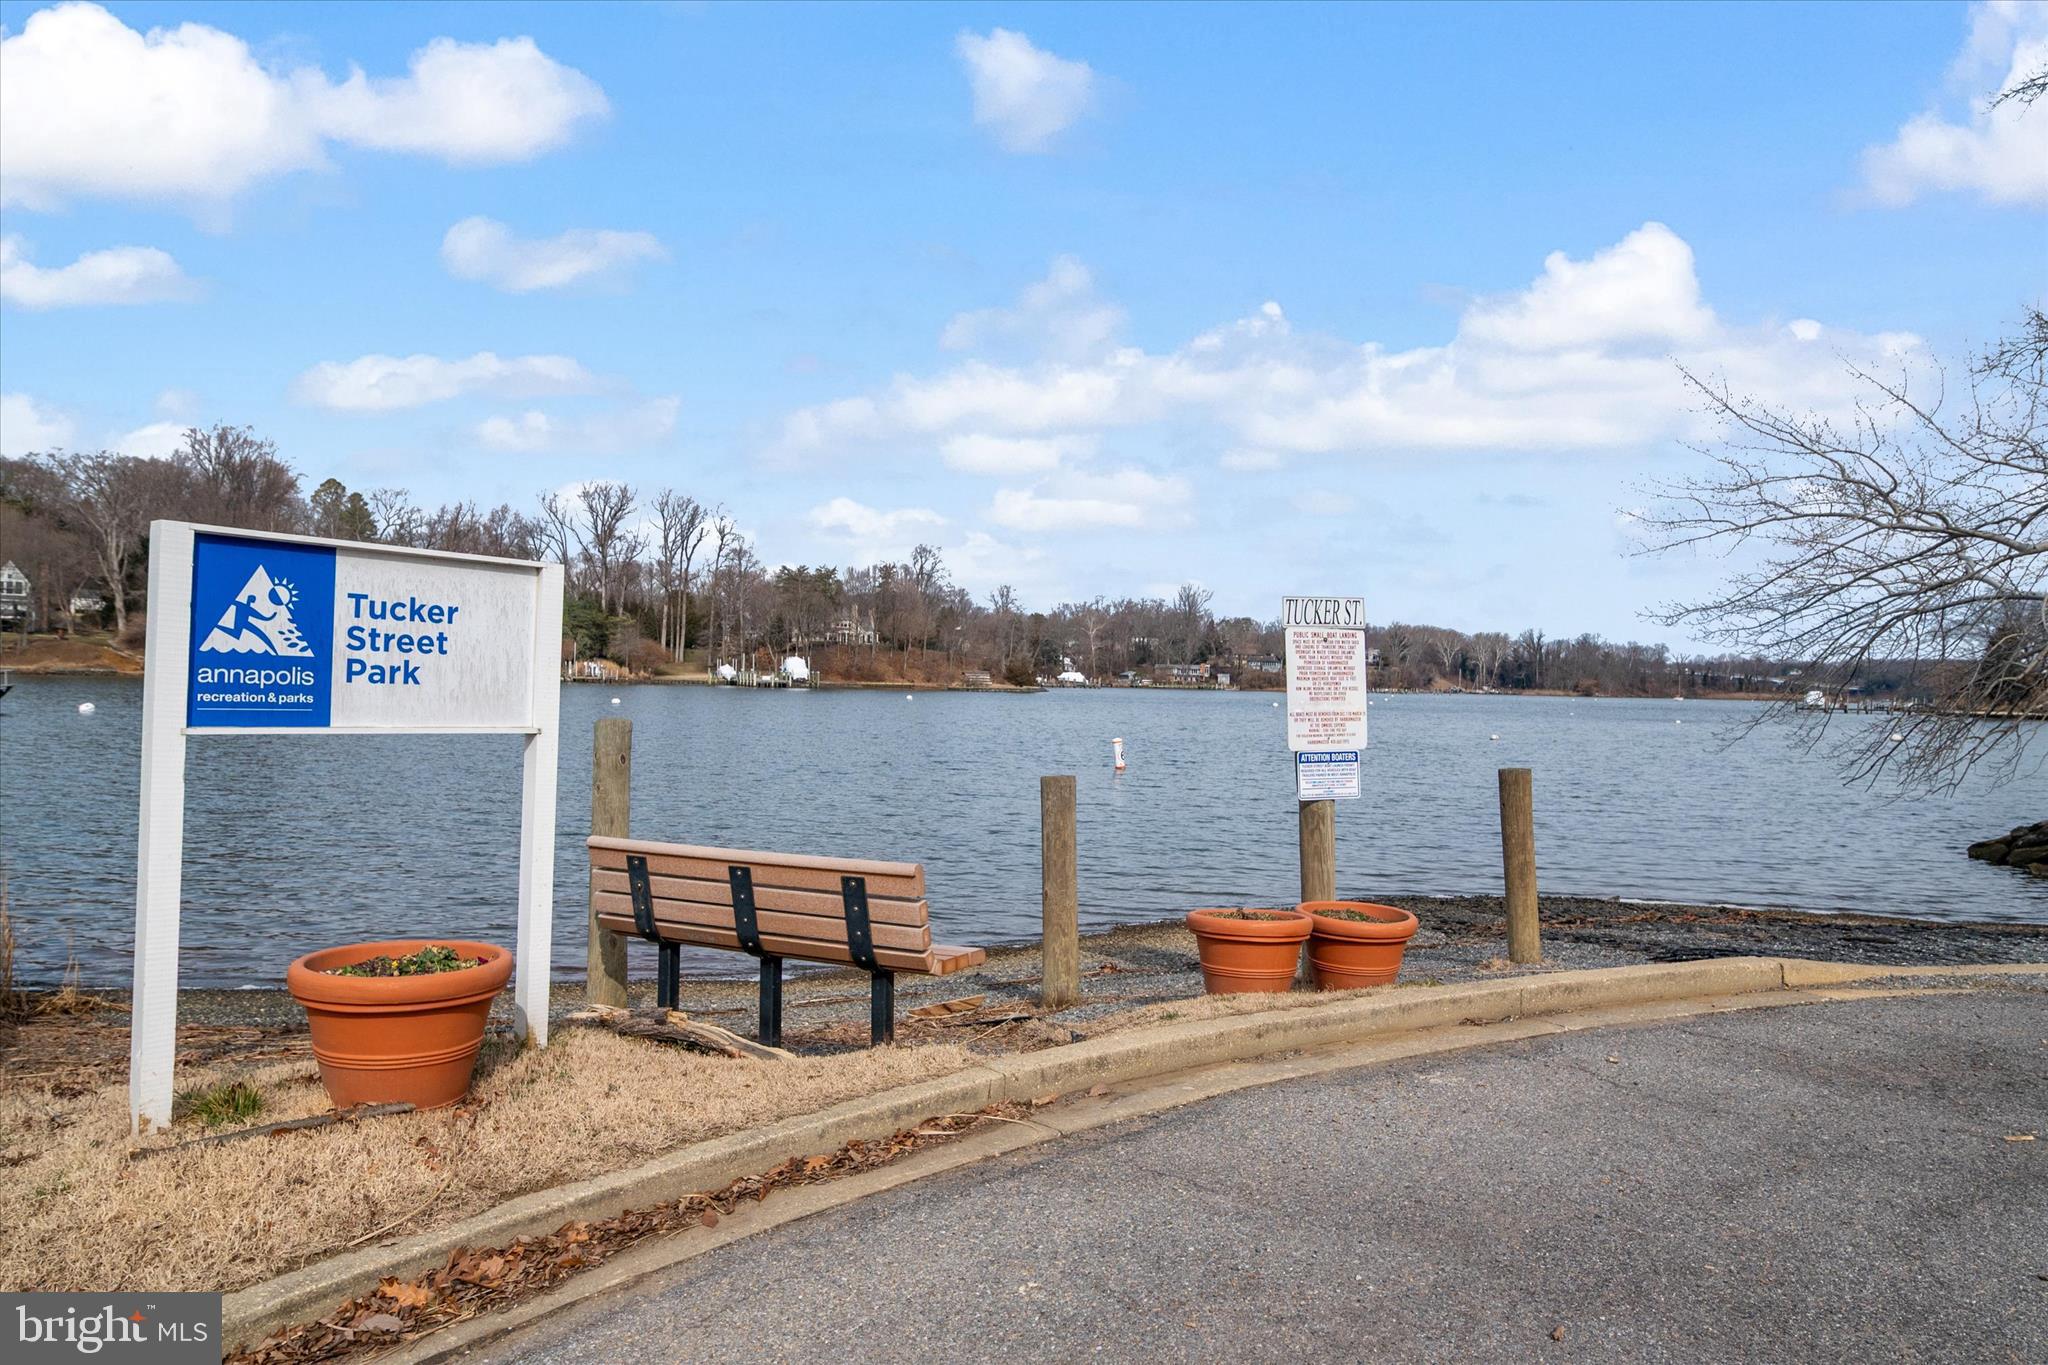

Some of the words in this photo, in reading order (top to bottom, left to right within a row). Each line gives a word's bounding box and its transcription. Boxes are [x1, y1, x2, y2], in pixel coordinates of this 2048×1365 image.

[347, 593, 459, 624] Tucker
[1285, 599, 1340, 625] TUCKER
[1344, 599, 1363, 625] ST.
[346, 626, 448, 655] Street
[197, 666, 314, 689] annapolis
[346, 658, 421, 686] Park
[197, 691, 265, 703] recreation
[267, 692, 277, 703] &
[278, 692, 314, 705] parks
[1301, 753, 1330, 762] ATTENTION
[1332, 753, 1356, 762] BOATERS
